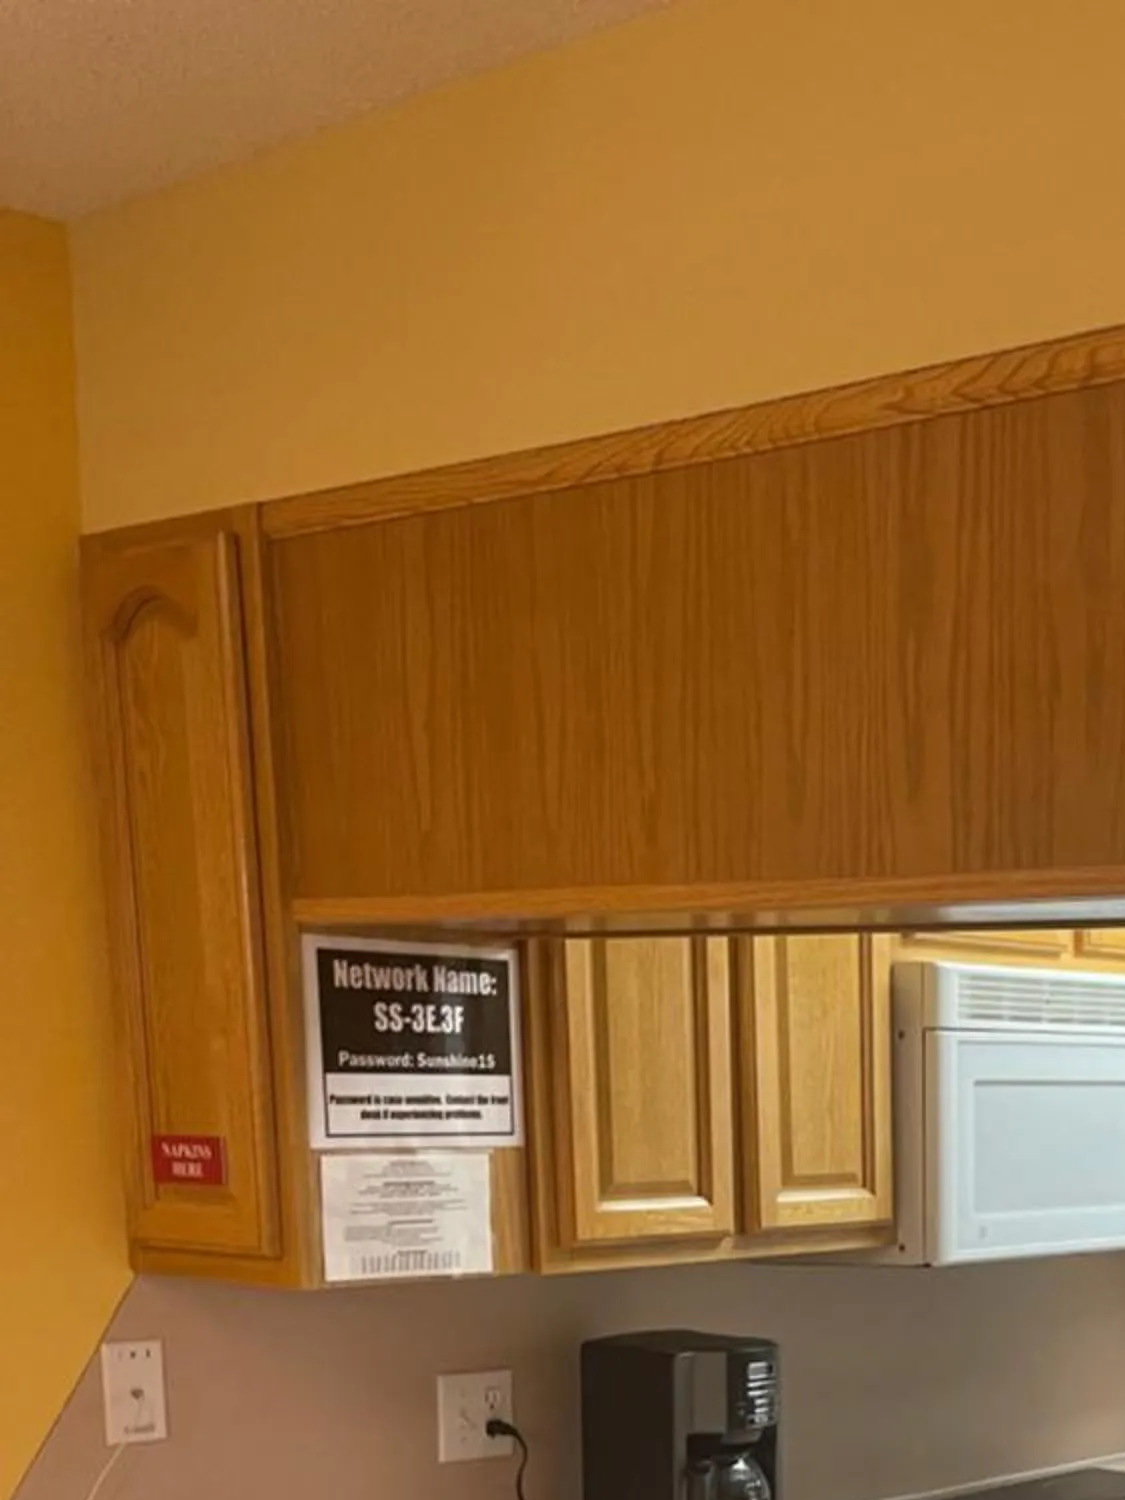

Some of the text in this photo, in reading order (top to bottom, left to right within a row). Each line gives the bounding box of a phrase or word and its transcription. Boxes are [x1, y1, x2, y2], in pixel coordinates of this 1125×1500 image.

[333, 959, 497, 996] Network Name:
[338, 1050, 415, 1068] Password:
